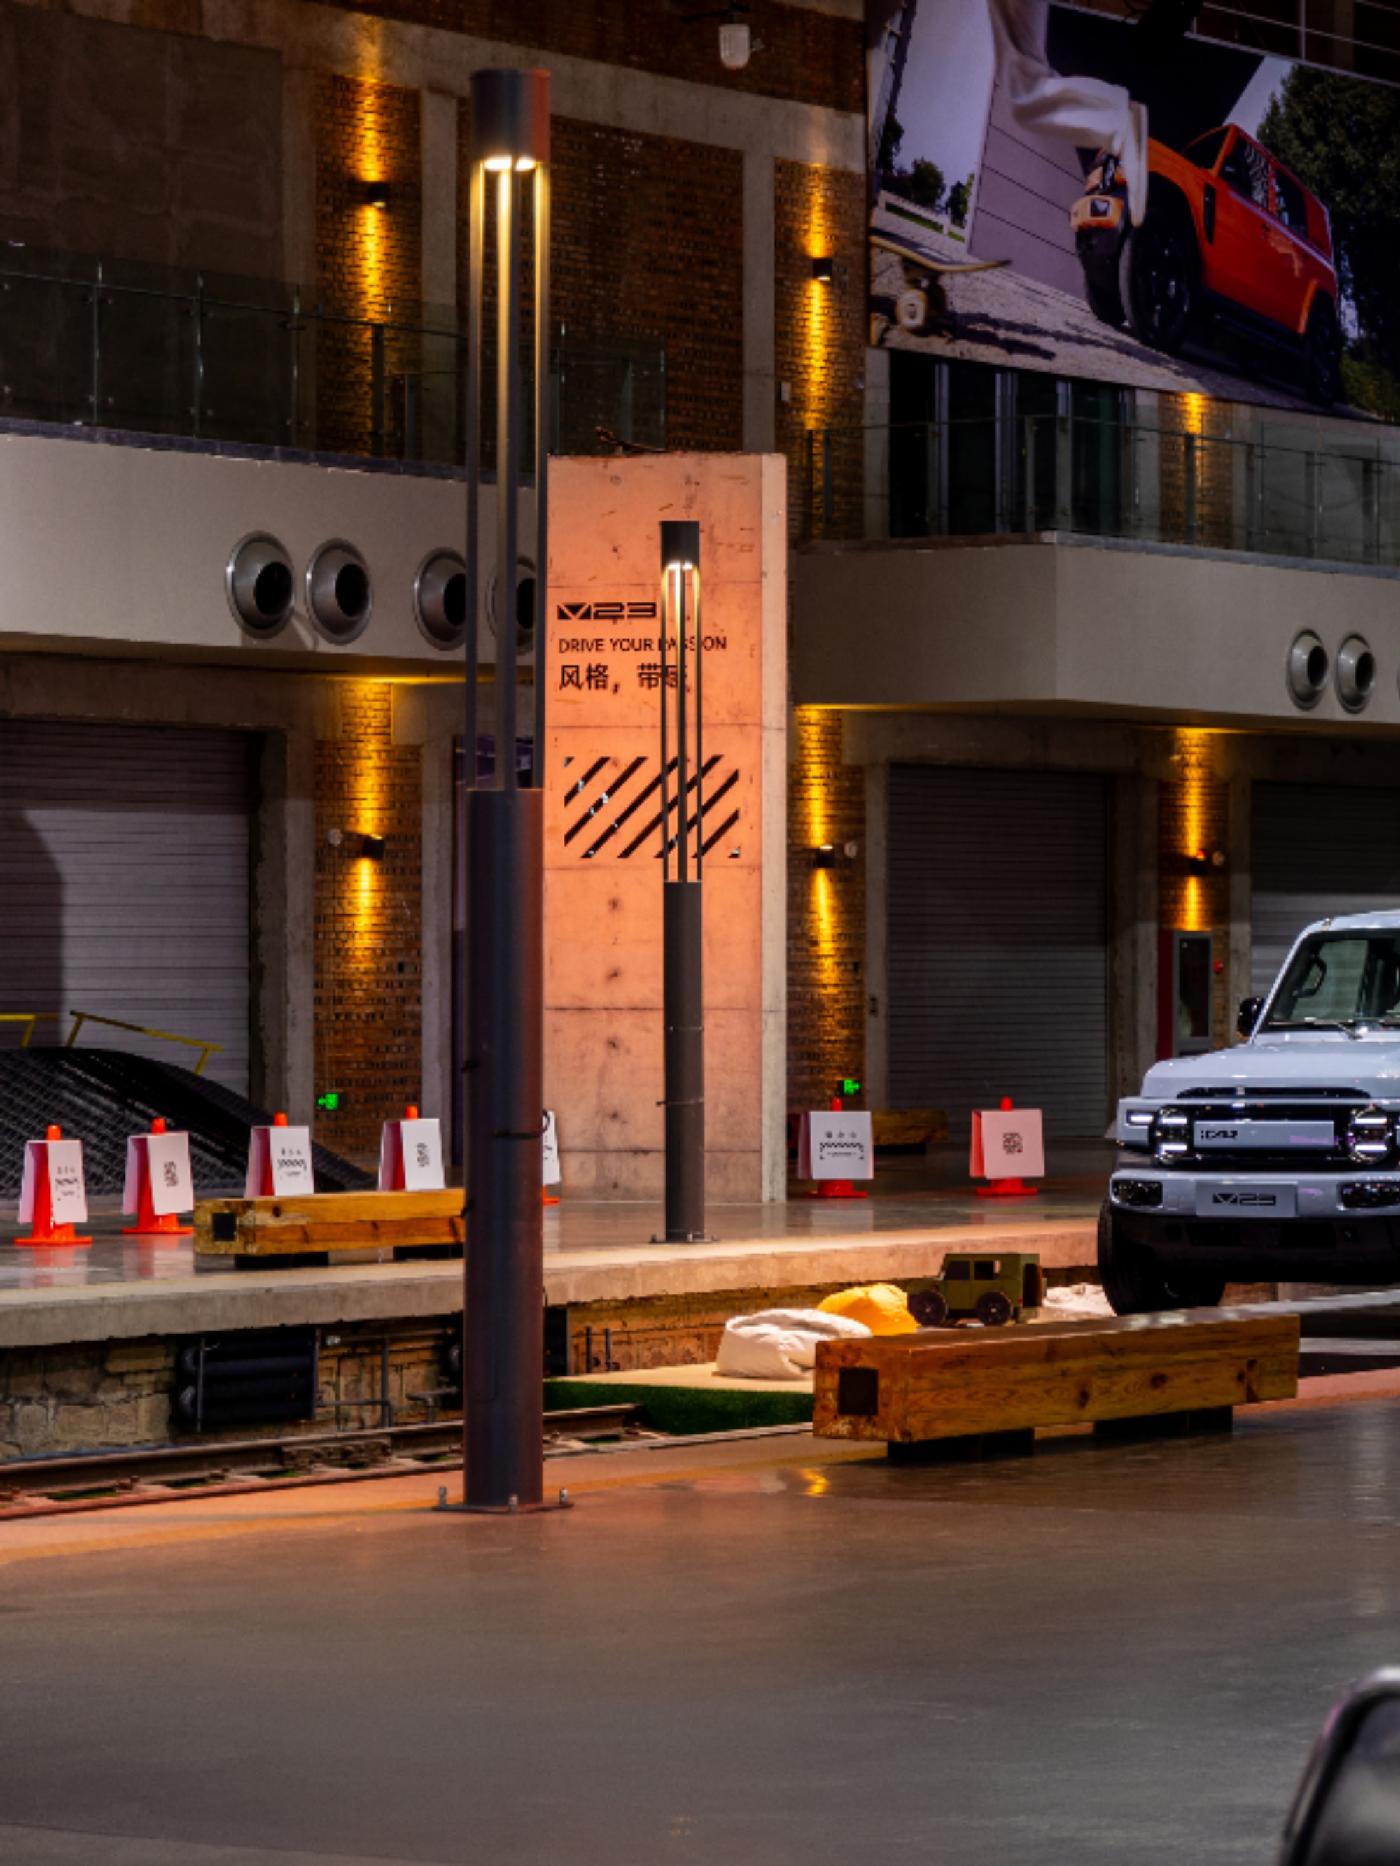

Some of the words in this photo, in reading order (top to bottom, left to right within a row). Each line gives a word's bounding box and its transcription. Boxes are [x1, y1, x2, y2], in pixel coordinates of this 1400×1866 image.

[557, 602, 656, 620] V23
[559, 638, 604, 654] DRIVE
[610, 637, 653, 652] YOUR
